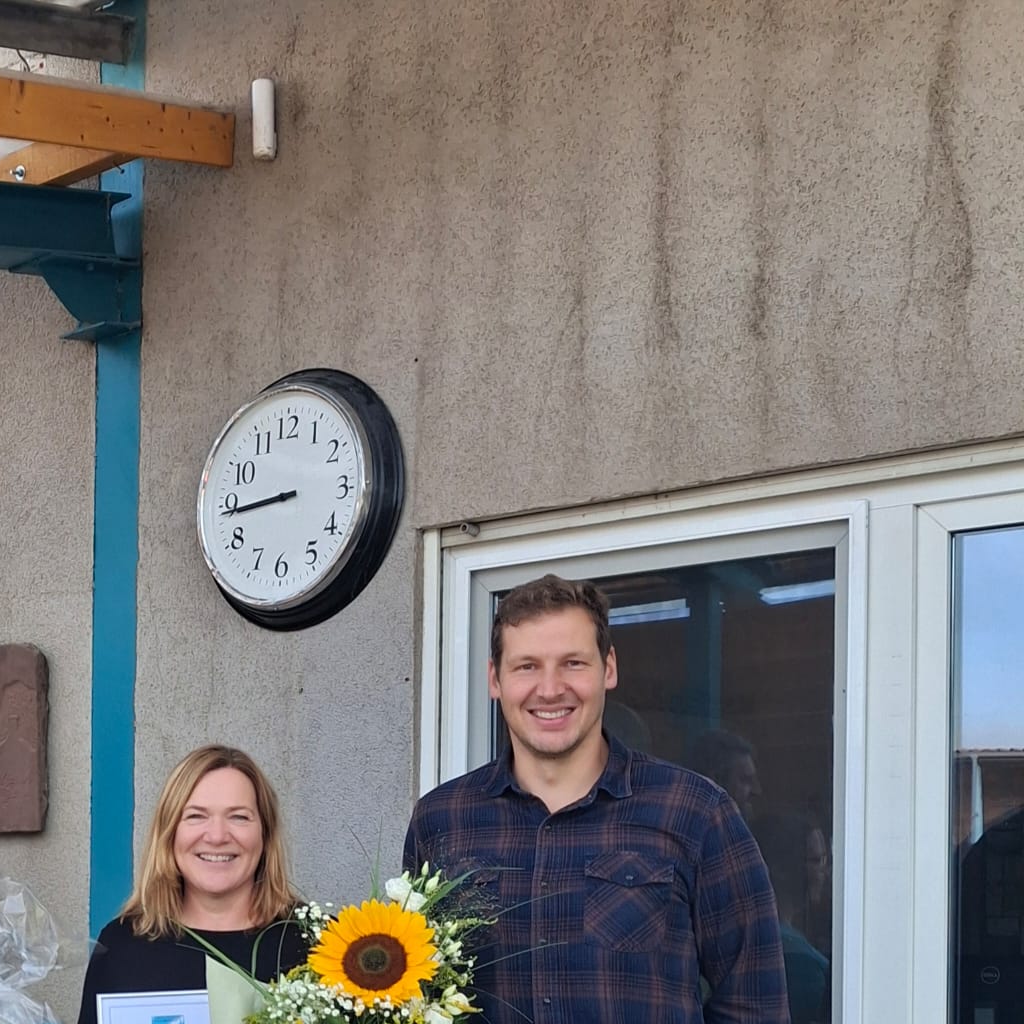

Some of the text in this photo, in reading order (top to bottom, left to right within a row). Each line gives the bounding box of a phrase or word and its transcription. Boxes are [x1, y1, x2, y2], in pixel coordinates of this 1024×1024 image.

[276, 415, 299, 440] 12
[311, 421, 319, 444] 1
[254, 431, 271, 456] 11
[326, 439, 339, 463] 2
[235, 461, 255, 486] 10
[336, 475, 348, 500] 3
[224, 493, 239, 517] 9
[323, 511, 338, 536] 4
[231, 526, 244, 550] 8
[252, 547, 264, 571] 7
[274, 552, 288, 578] 6
[306, 540, 318, 565] 5
